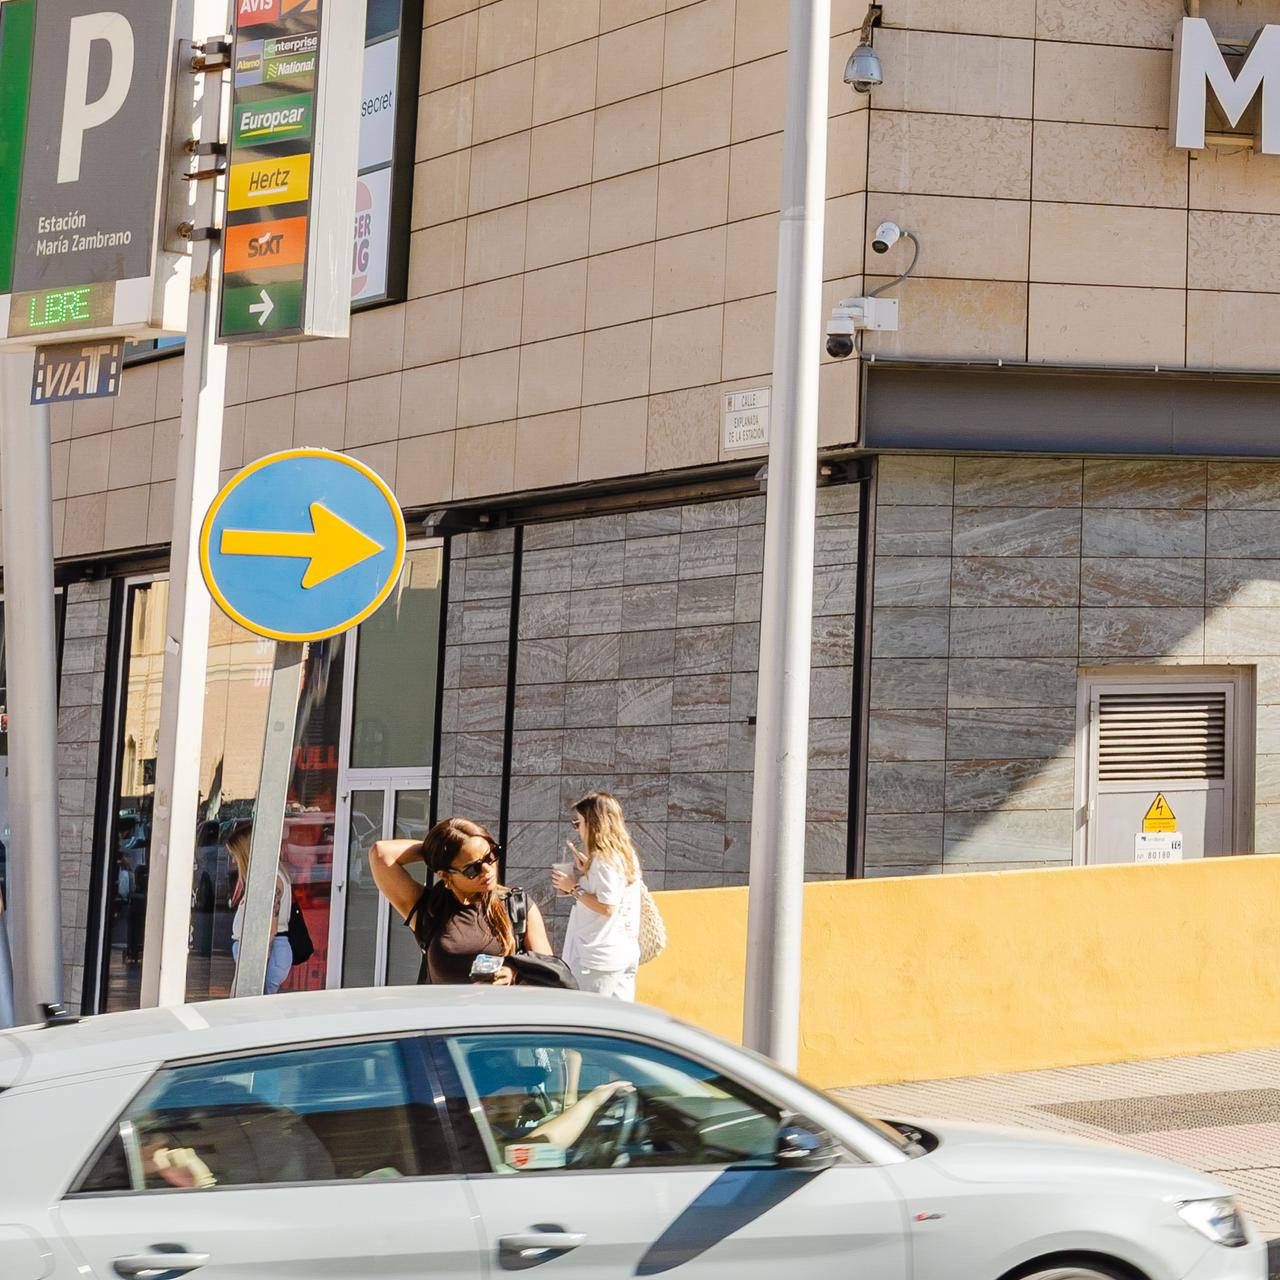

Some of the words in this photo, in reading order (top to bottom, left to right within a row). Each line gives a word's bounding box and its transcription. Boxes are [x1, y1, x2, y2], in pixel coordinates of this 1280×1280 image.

[267, 36, 318, 53] enterprise
[236, 59, 261, 71] Alamo
[278, 57, 315, 76] National
[56, 11, 136, 185] P
[240, 106, 305, 133] Europcar
[249, 167, 291, 191] Hertz
[38, 210, 87, 234] Estación
[36, 234, 69, 257] María
[71, 229, 132, 252] Zambrano
[30, 287, 91, 327] LIBRE
[741, 393, 756, 408] CALLE
